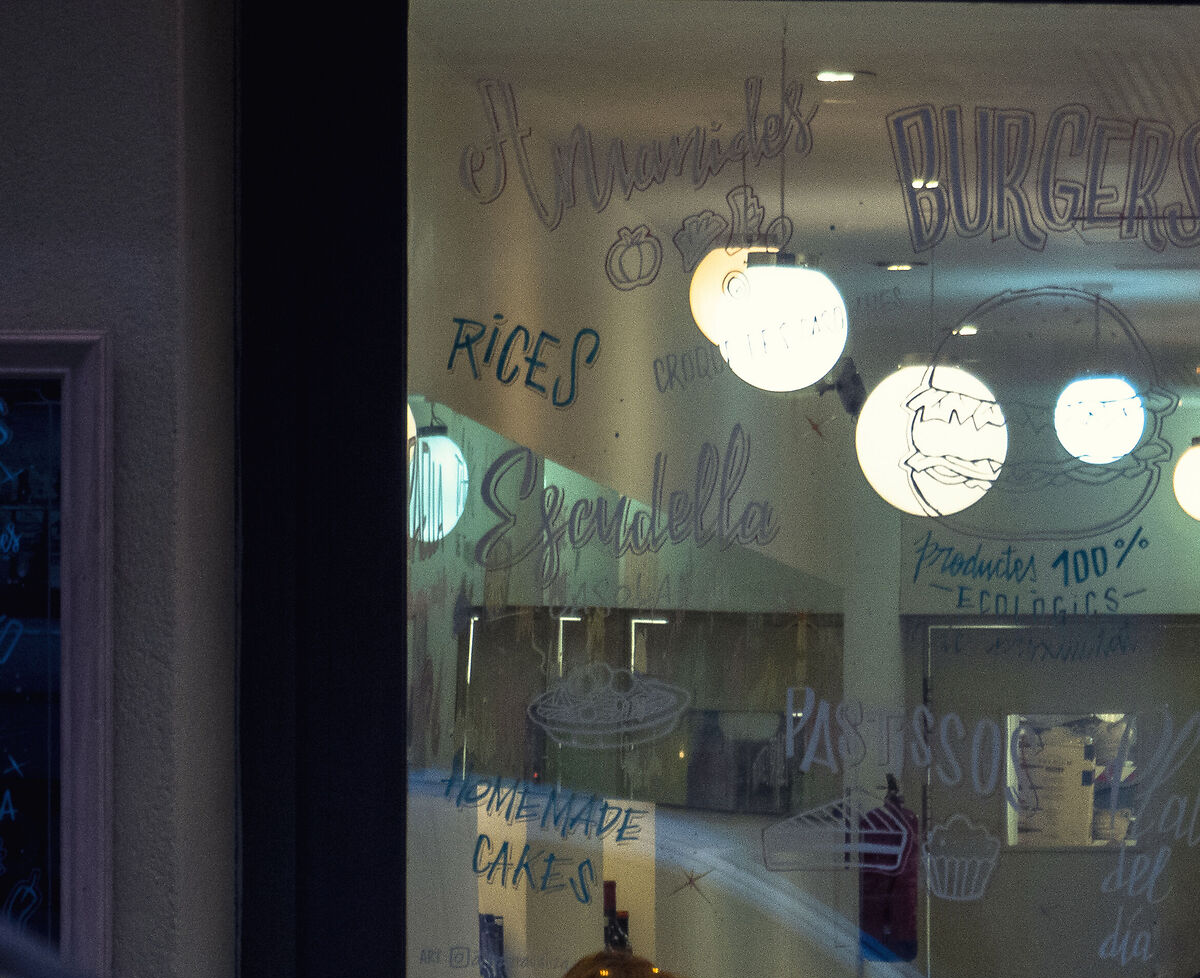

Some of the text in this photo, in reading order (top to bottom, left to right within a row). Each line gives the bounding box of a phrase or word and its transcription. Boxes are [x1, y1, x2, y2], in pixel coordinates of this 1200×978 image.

[475, 423, 782, 590] Escudella
[1052, 526, 1150, 587] 100%
[441, 772, 649, 843] HOMEMADE
[472, 834, 595, 905] CAKES
